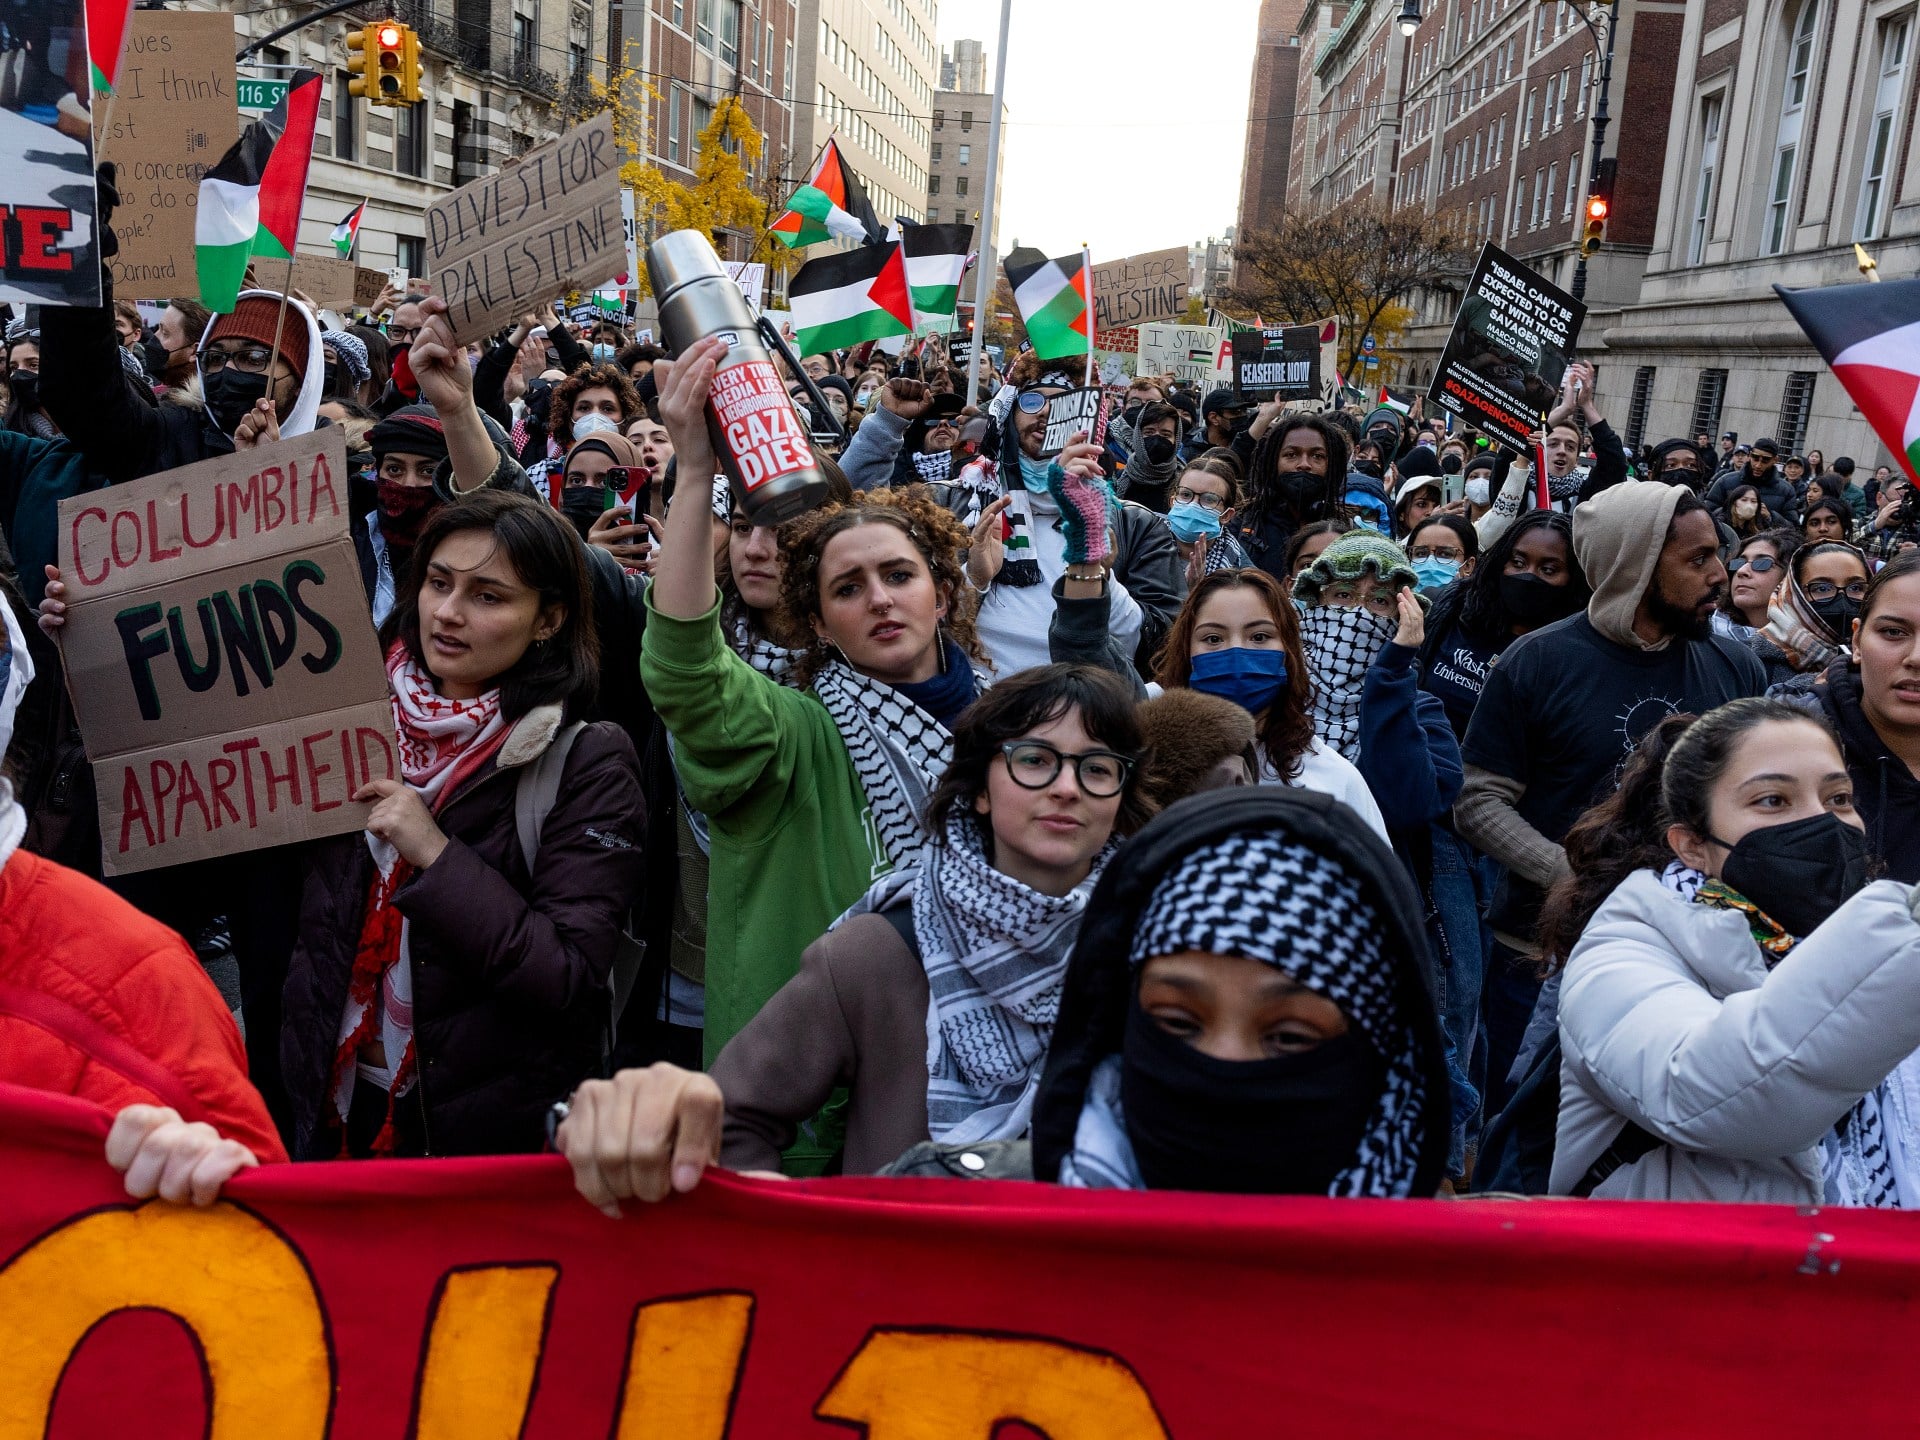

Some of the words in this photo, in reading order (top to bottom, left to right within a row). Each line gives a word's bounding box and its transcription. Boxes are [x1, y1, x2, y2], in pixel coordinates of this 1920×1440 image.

[158, 68, 229, 101] think
[239, 85, 263, 104] 116
[271, 86, 286, 105] St
[151, 184, 177, 209] do
[429, 154, 547, 260] DIVEST
[557, 129, 609, 195] FOR
[117, 213, 154, 246] ople?
[109, 252, 176, 285] Barnard
[358, 271, 386, 287] FREE
[441, 199, 617, 334] PALESTINE
[1143, 258, 1180, 285] FOR
[1094, 283, 1189, 326] PALESTINE
[1482, 272, 1533, 311] EXPECTED
[1534, 305, 1549, 321] TO
[1549, 317, 1569, 334] CO-
[1491, 260, 1527, 294] "ISRAEL
[1528, 288, 1560, 313] CAN'T
[1559, 307, 1573, 322] BE
[590, 305, 635, 326] GENOCIDE
[1478, 285, 1508, 310] EXIST
[1508, 304, 1534, 328] WITH
[1536, 321, 1566, 349] THESE
[1020, 340, 1031, 351] WE
[1147, 330, 1163, 348] I
[1173, 330, 1217, 349] STAND
[1263, 330, 1283, 338] FREE
[1486, 322, 1516, 345] MARCO
[1517, 341, 1539, 359] RUBIO
[1145, 358, 1213, 382] PALESTINE
[1163, 351, 1186, 362] WITH
[1241, 362, 1286, 384] CEASEFIRE
[1287, 361, 1311, 382] NOW
[709, 366, 746, 396] EVERY
[747, 363, 778, 379] TIME
[712, 381, 757, 412] MEDIA
[756, 378, 784, 393] LIES
[1452, 361, 1485, 384] PALESTINIAN
[1484, 381, 1508, 400] CHILDREN
[1514, 399, 1529, 412] GAZA
[1528, 408, 1539, 418] ARE
[1048, 391, 1083, 425] ZIONISM
[1082, 390, 1100, 417] IS
[1445, 378, 1532, 437] #GAZAGENOCIDE
[1446, 367, 1463, 380] BEING
[1462, 377, 1494, 400] MASSACRED
[1493, 396, 1502, 405] AS
[1502, 401, 1514, 412] YOU
[1513, 408, 1527, 420] READ
[1527, 416, 1539, 427] THIS
[719, 411, 728, 428] A
[727, 408, 804, 455] GAZA
[1482, 420, 1527, 451] @WOLPALESTINE
[737, 436, 815, 488] DIES
[72, 453, 340, 586] COLUMBIA
[114, 559, 342, 721] FUNDS
[1433, 662, 1483, 695] University
[118, 727, 394, 853] APARTHEID
